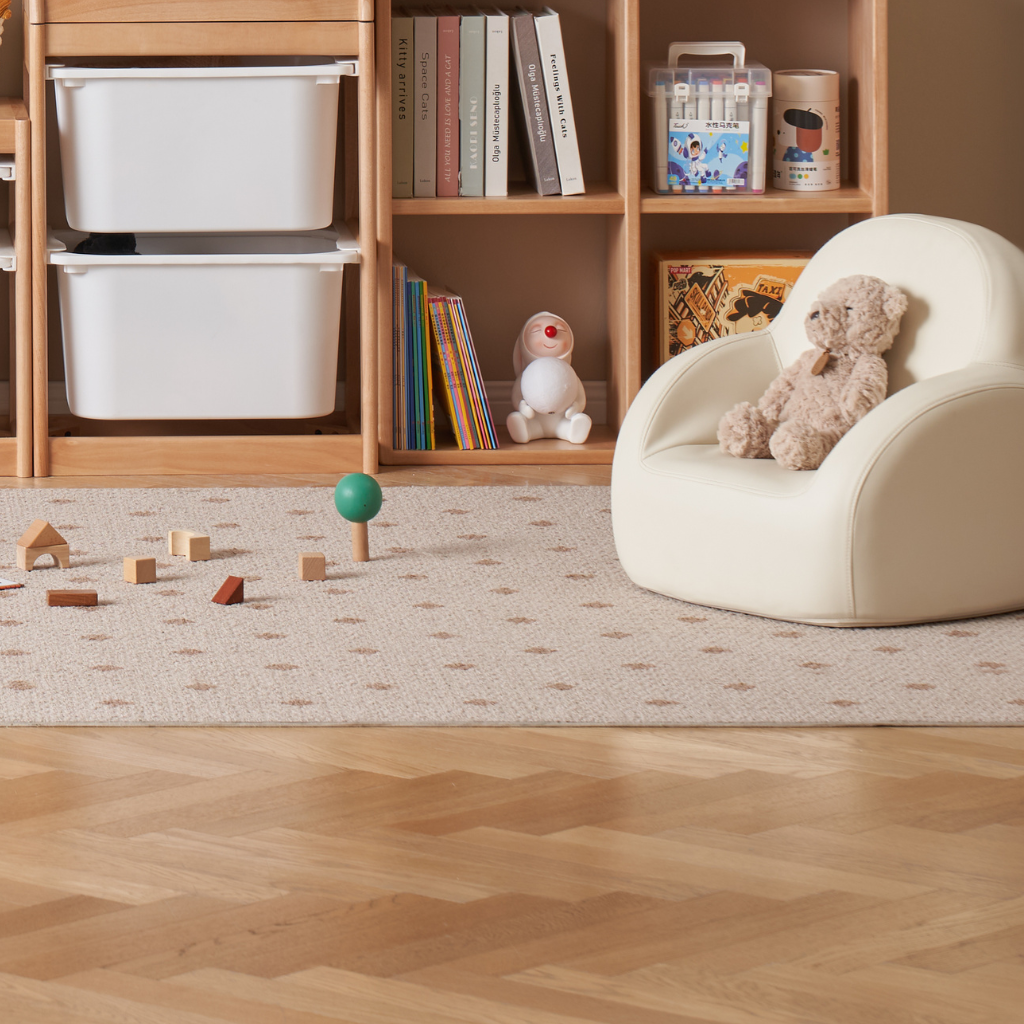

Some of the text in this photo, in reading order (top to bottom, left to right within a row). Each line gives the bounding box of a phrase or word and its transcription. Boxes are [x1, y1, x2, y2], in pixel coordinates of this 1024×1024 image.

[398, 38, 408, 120] Kitty arrives
[420, 52, 430, 121] Space Cats
[550, 54, 560, 91] Feelings
[557, 95, 565, 115] With
[492, 145, 501, 162] Olga
[757, 283, 783, 295] TAXI
